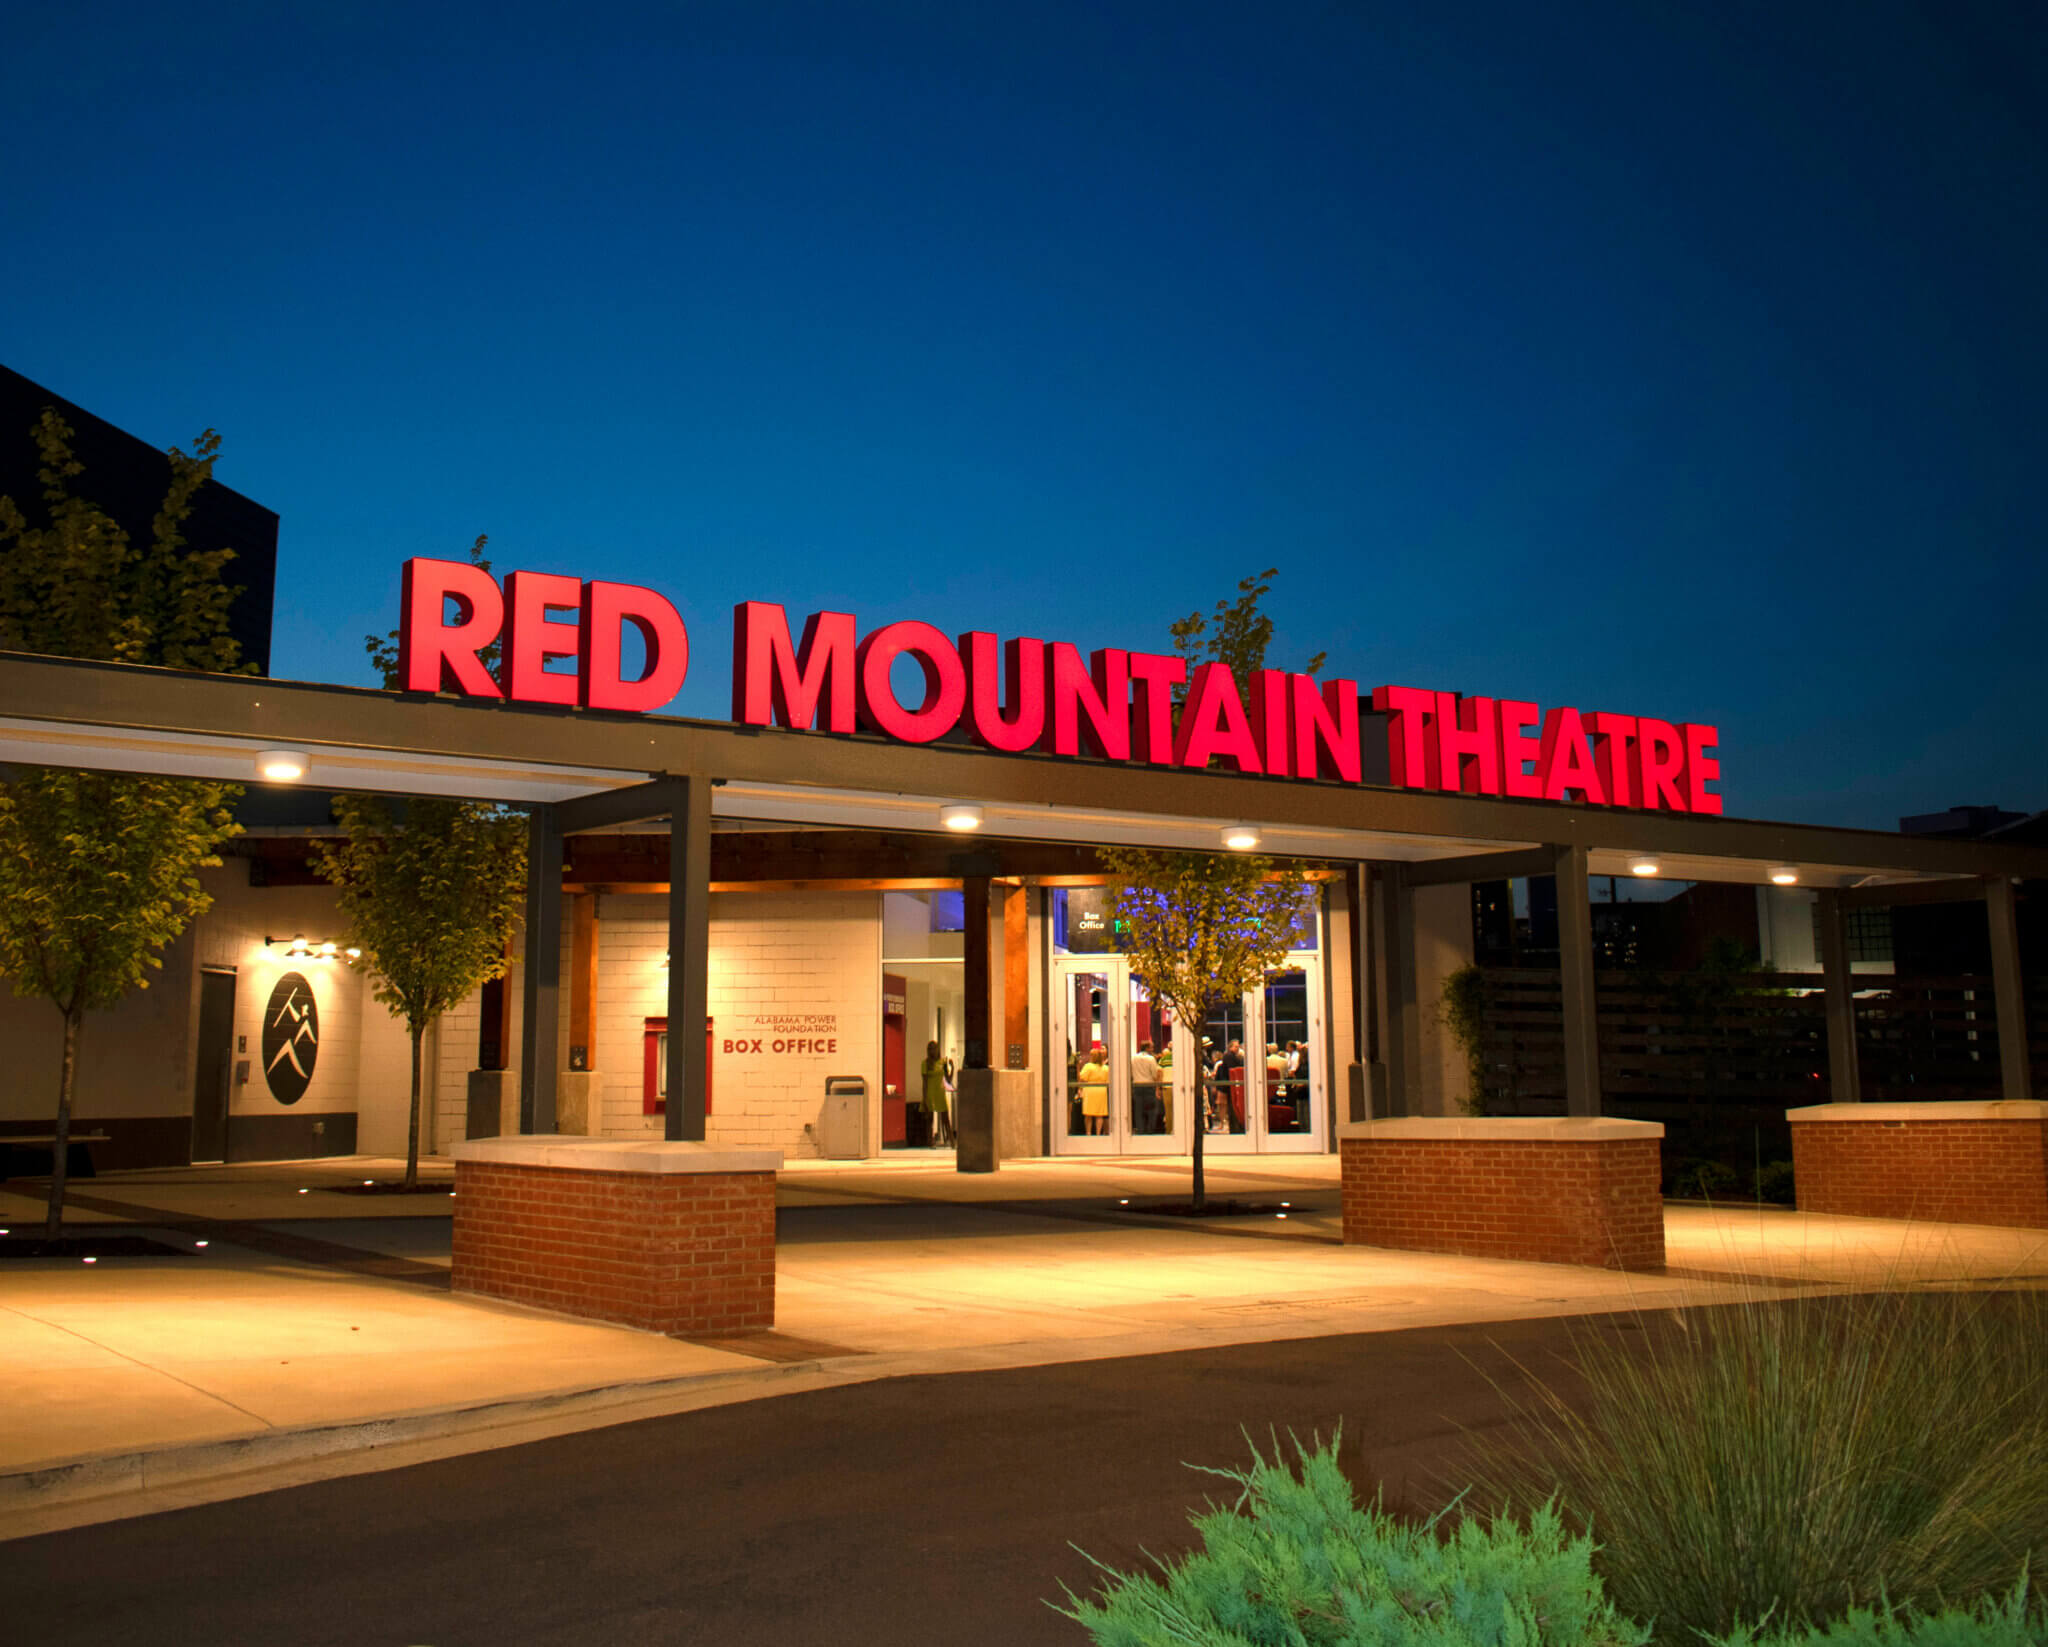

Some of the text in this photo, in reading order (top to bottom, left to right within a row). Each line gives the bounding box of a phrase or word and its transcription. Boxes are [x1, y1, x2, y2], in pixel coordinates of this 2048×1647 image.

[402, 557, 1722, 815] RED MOUNTAIN THEATRE
[1083, 911, 1100, 920] Box
[1079, 920, 1105, 929] Office
[754, 1015, 836, 1024] ALABAMA POWER
[773, 1025, 837, 1033] FOUNDATION
[723, 1039, 837, 1054] BOX OFFICE
